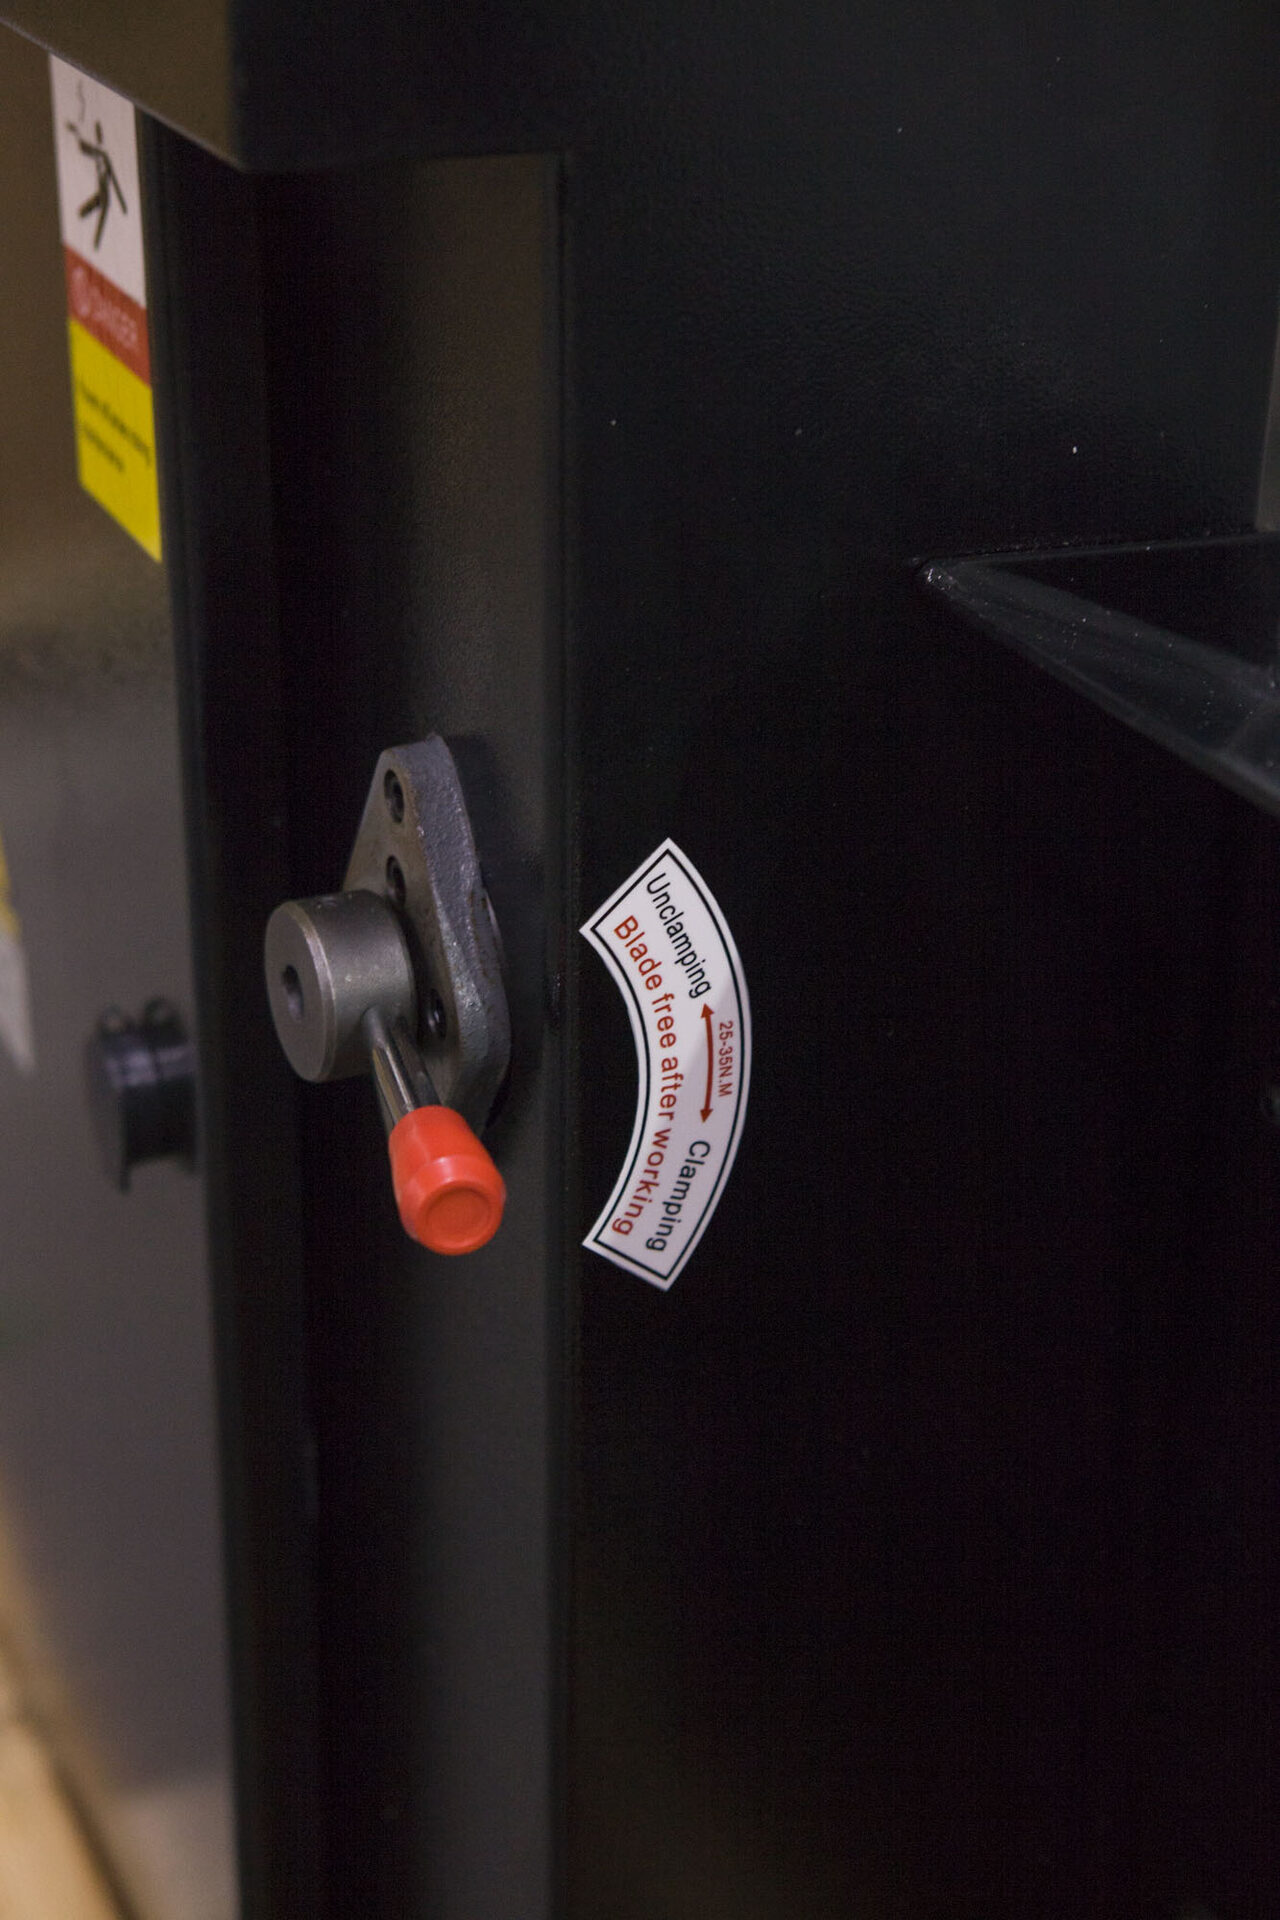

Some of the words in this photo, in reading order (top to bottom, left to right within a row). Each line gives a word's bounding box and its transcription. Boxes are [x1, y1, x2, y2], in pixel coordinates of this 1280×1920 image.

[613, 914, 663, 992] Blade
[646, 872, 712, 999] Unclamping
[651, 993, 677, 1049] free
[718, 1019, 734, 1098] 25-35N.M
[659, 1057, 685, 1122] after
[611, 1128, 672, 1237] working
[645, 1140, 712, 1253] Clamping
